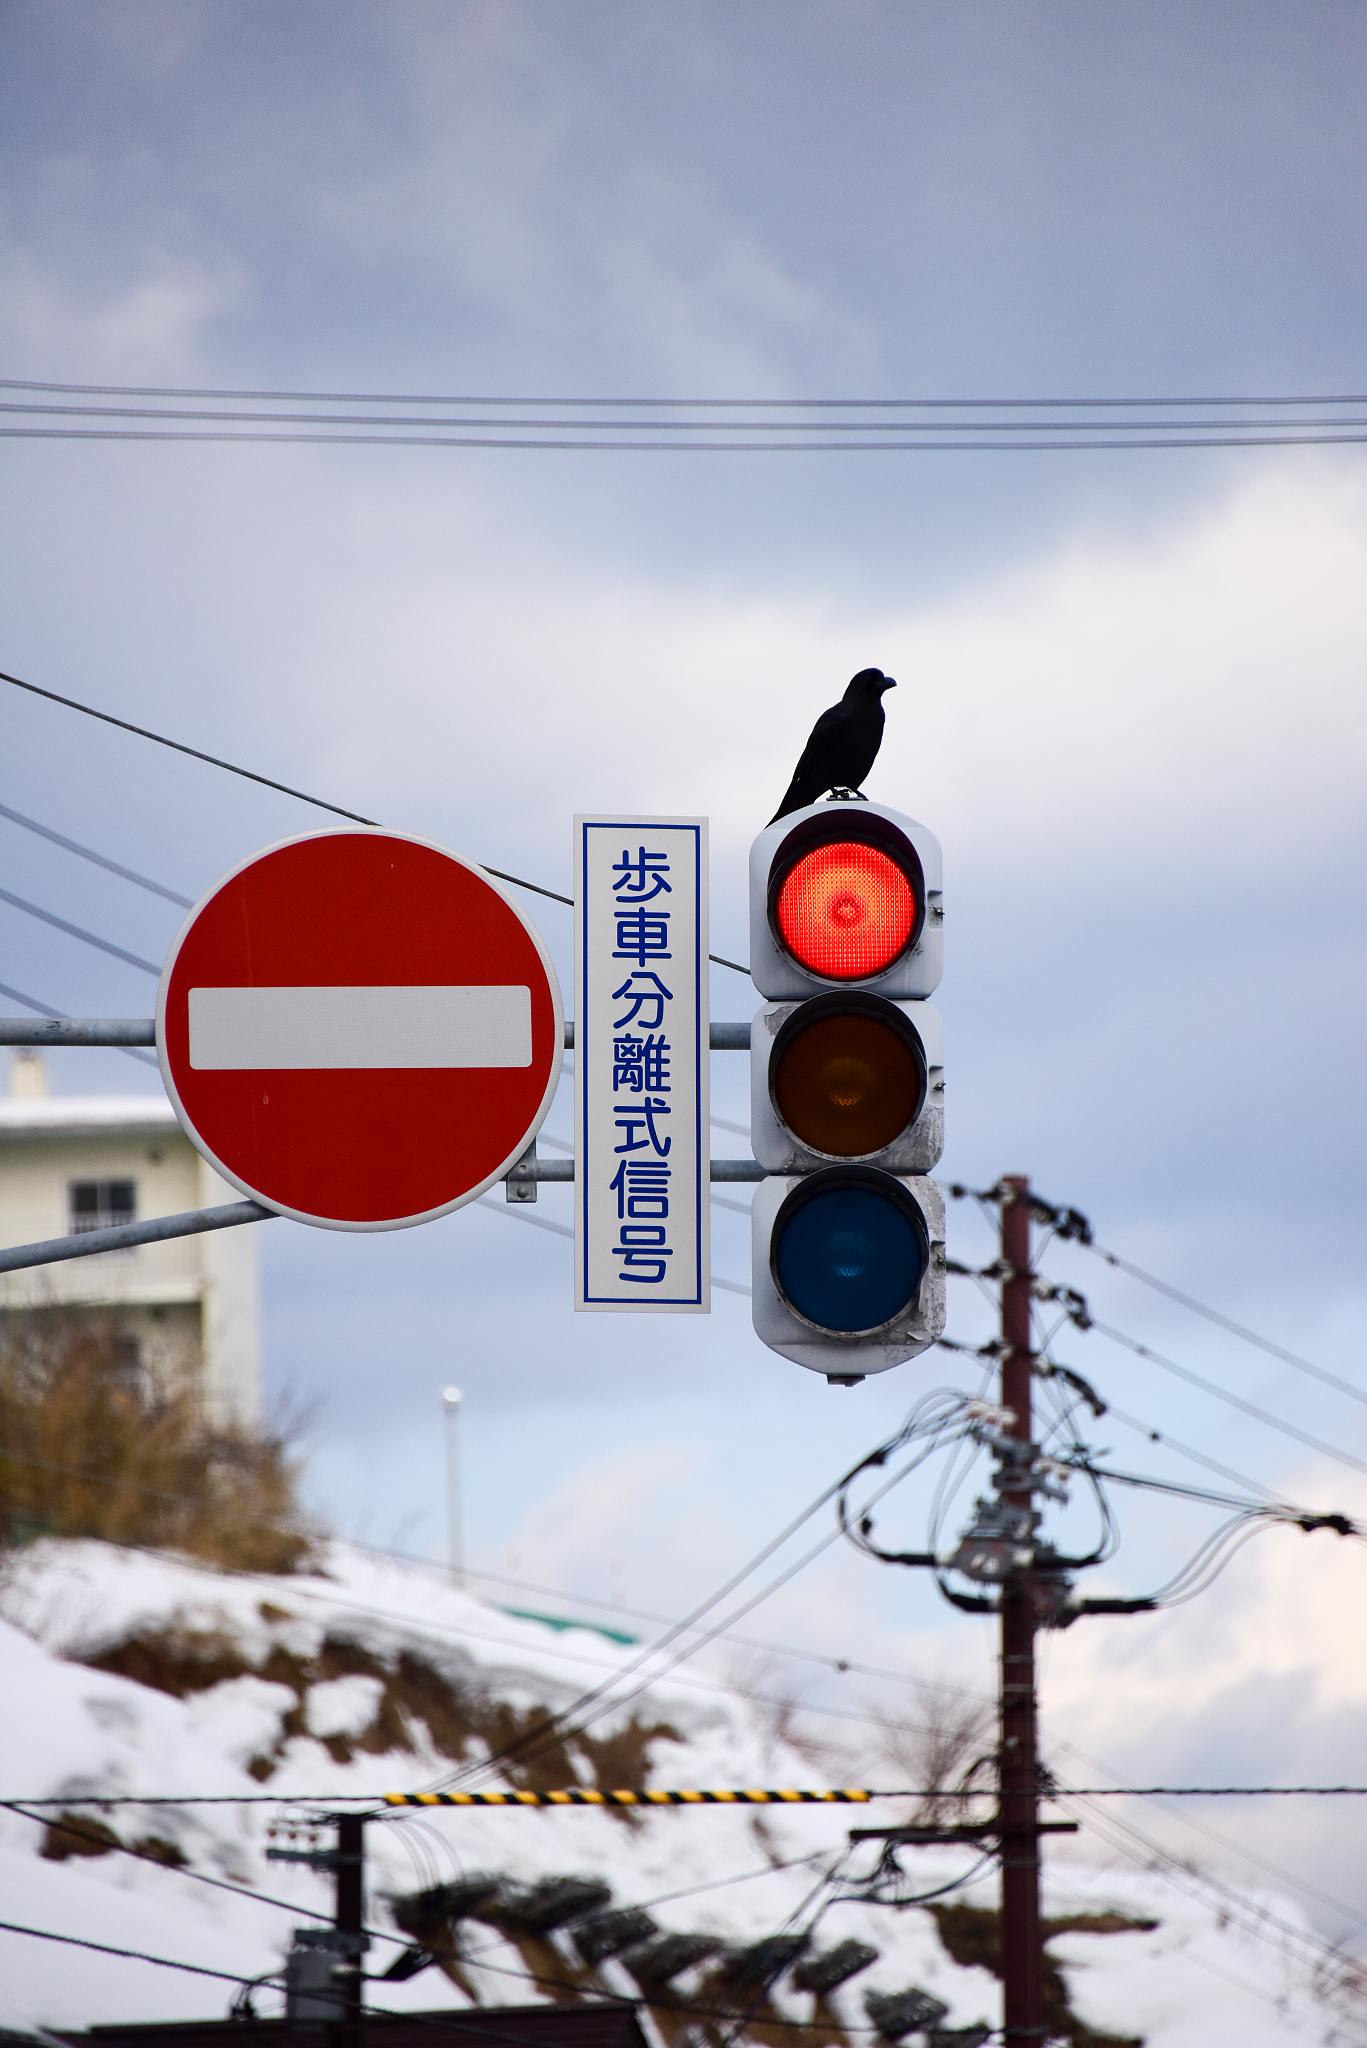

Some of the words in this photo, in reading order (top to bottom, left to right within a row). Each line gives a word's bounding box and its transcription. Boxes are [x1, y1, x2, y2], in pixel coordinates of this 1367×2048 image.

[609, 845, 673, 1283] 歩車分離式信号
